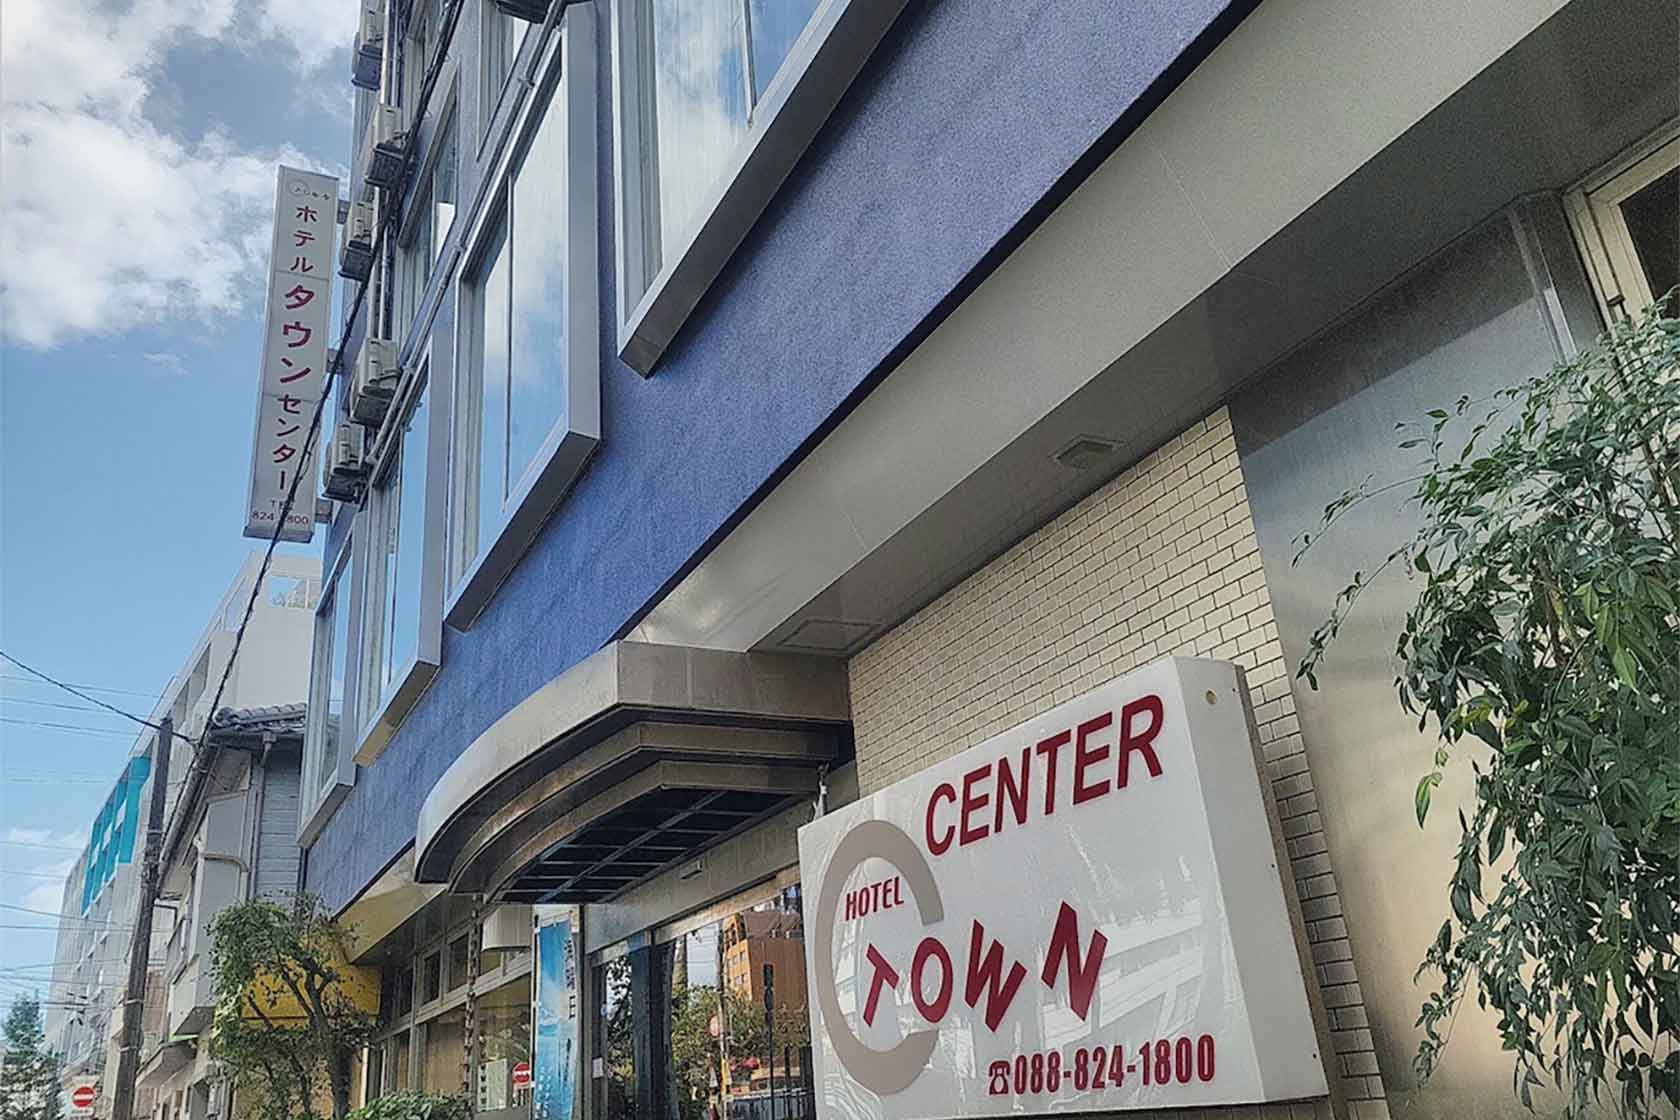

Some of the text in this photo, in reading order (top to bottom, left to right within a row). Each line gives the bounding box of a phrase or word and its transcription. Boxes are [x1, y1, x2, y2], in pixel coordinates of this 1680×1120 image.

[273, 205, 317, 490] ホテルタウンセンター
[926, 694, 1165, 856] CENTER
[845, 876, 904, 922] HOTEL
[863, 901, 1108, 1032] TOWN
[1014, 1034, 1216, 1095] 088-824-1800
